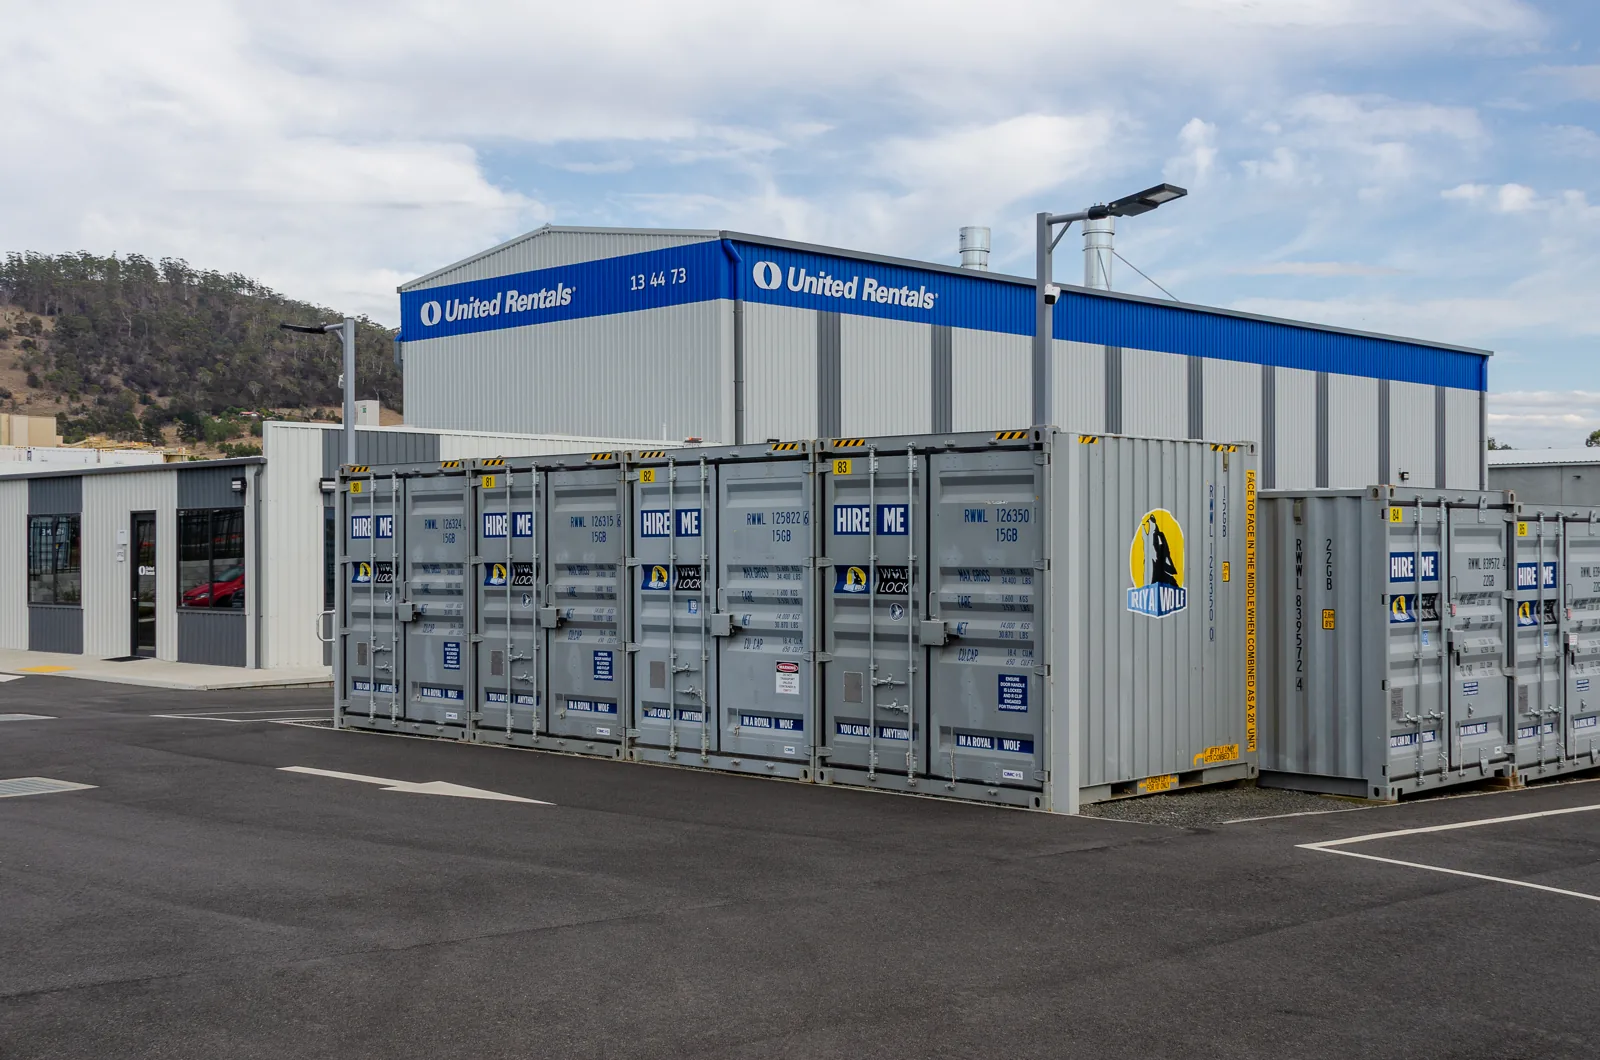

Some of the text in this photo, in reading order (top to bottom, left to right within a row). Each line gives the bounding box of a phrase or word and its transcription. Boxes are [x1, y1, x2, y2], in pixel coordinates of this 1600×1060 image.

[631, 268, 686, 290] 13 44 73
[787, 266, 934, 310] United Rentals
[445, 283, 572, 322] United Rentals
[838, 462, 847, 473] 83
[486, 477, 492, 487] 81
[644, 471, 651, 481] 82
[353, 483, 359, 492] 80
[1247, 498, 1255, 510] TO
[592, 516, 613, 527] 126315
[772, 512, 800, 524] 125822
[836, 508, 904, 532] HIRE ME
[964, 508, 1029, 523] RWWL 126350
[353, 517, 392, 537] HIRE ME
[485, 514, 531, 536] HIRE ME
[643, 512, 698, 535] HIRE ME
[592, 532, 606, 542] 15GB
[772, 530, 791, 542] 15GB
[996, 528, 1018, 542] 15GB
[1247, 540, 1255, 549] IN
[1391, 556, 1434, 578] HIRE ME
[1518, 566, 1554, 586] HIRE ME
[880, 582, 908, 592] LOCK
[956, 622, 968, 635] NET
[1247, 689, 1255, 702] AS
[578, 702, 590, 711] ROYAL
[598, 703, 609, 712] WOLF
[658, 709, 666, 718] CAN
[682, 711, 702, 721] ANYTHIN
[743, 716, 794, 729] IN A ROYAL WOLF
[840, 724, 851, 733] YOU
[852, 726, 863, 735] CAN
[959, 736, 1020, 750] IN A ROYAL WOLF
